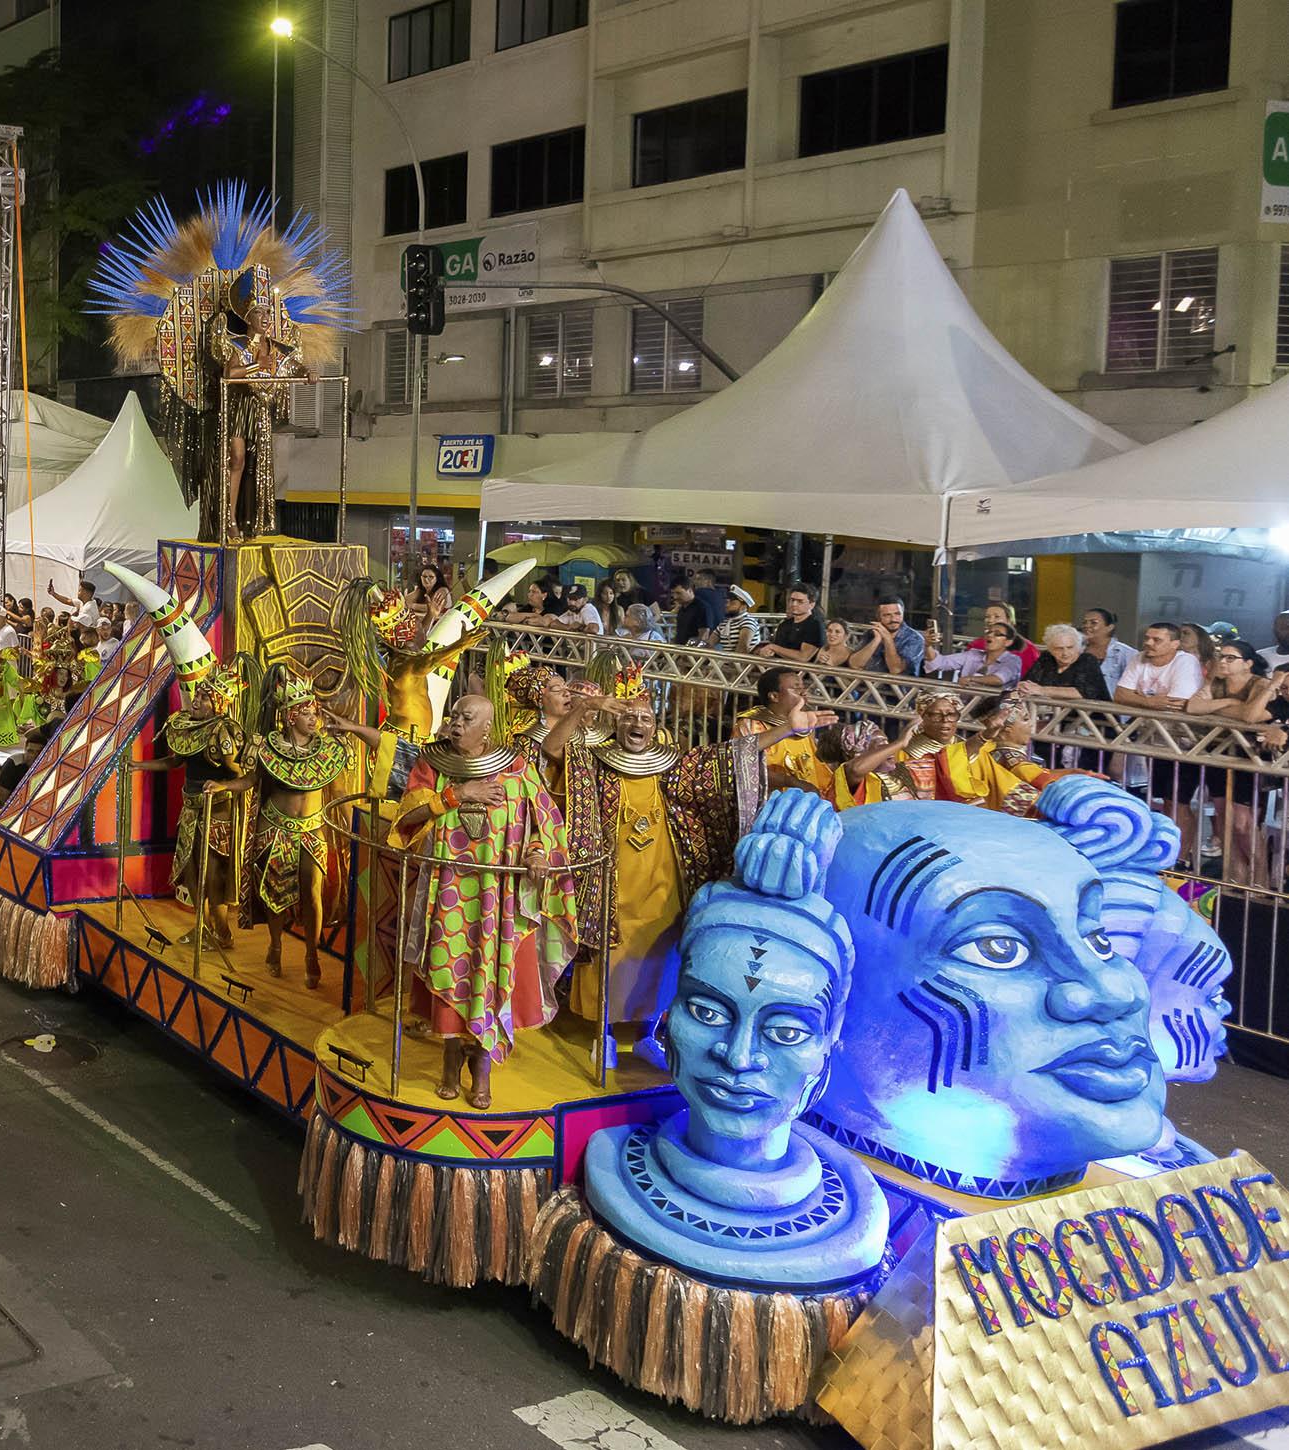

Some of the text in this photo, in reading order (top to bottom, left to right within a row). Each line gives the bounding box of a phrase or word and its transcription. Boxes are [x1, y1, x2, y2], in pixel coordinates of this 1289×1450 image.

[498, 250, 535, 266] Razão
[449, 292, 487, 305] 3028-2030
[673, 553, 731, 565] SEMANA
[950, 1173, 1289, 1336] MOCIDADE
[1090, 1286, 1289, 1418] AZUL
